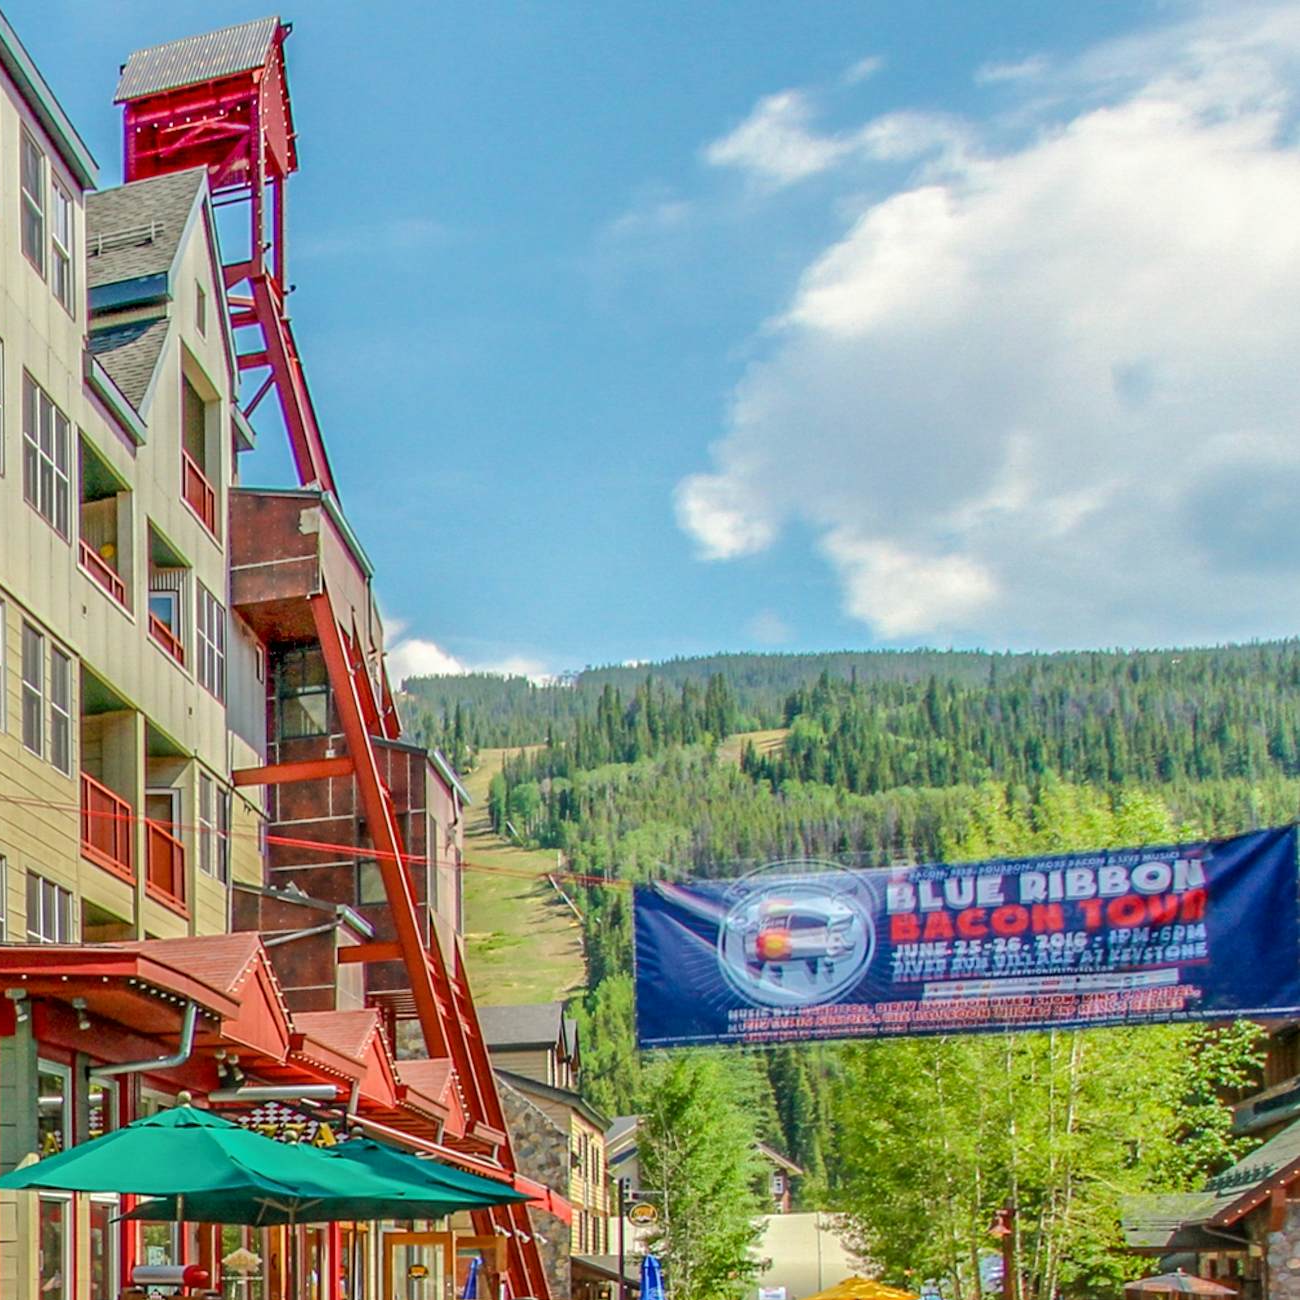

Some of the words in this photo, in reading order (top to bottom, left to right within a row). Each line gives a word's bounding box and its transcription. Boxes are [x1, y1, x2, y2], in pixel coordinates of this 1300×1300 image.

[886, 875, 1004, 915] BLUE
[1019, 859, 1206, 904] RIBBON
[890, 904, 1064, 941] BACON
[1078, 888, 1208, 928] TOUR
[993, 950, 1075, 969] VILLAGE
[1079, 948, 1105, 964] AT
[1108, 941, 1208, 964] KEYSTONE
[1035, 931, 1088, 951] 2016
